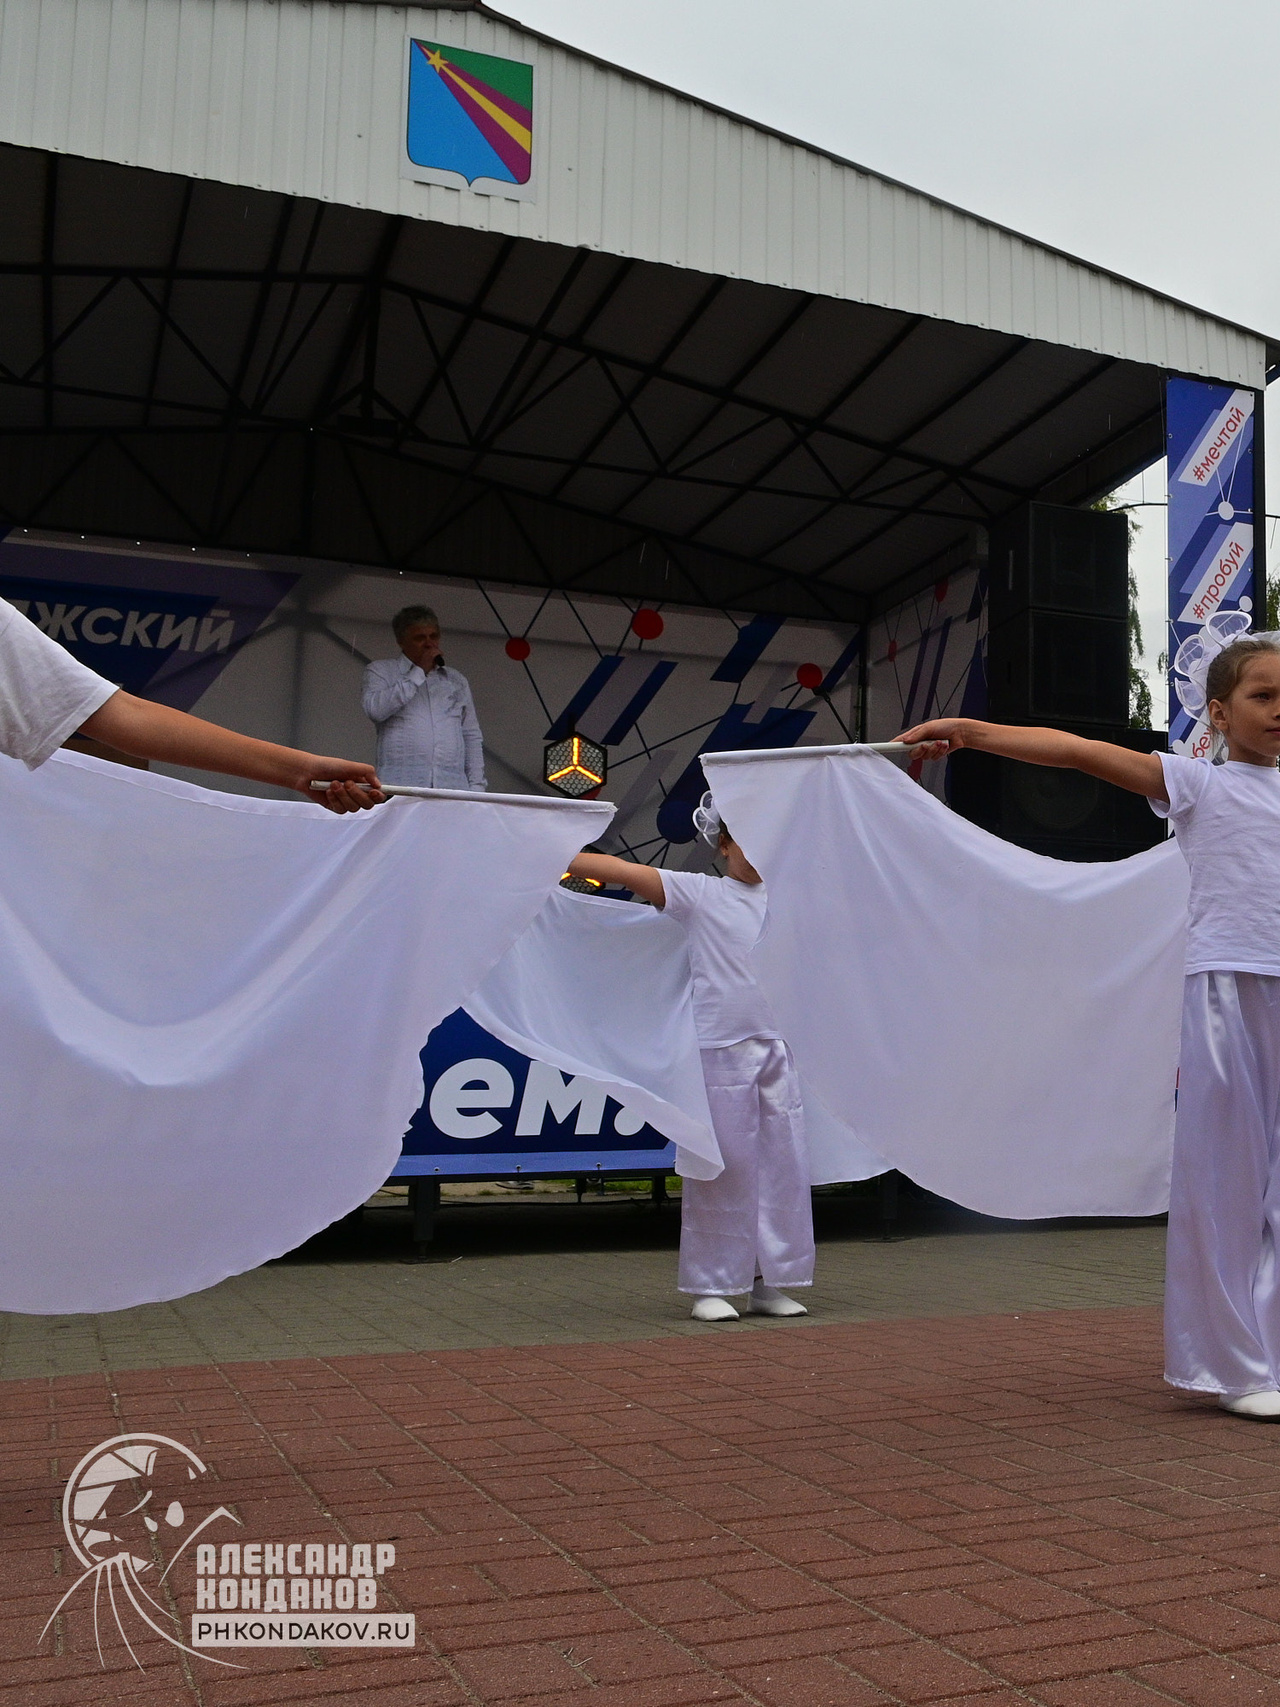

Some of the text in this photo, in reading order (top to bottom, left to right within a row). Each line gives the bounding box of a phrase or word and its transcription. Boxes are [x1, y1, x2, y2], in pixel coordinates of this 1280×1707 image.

[1192, 406, 1245, 482] #мечтай
[1192, 541, 1245, 620] #пробуй
[8, 599, 236, 654] ЖСКИЙ
